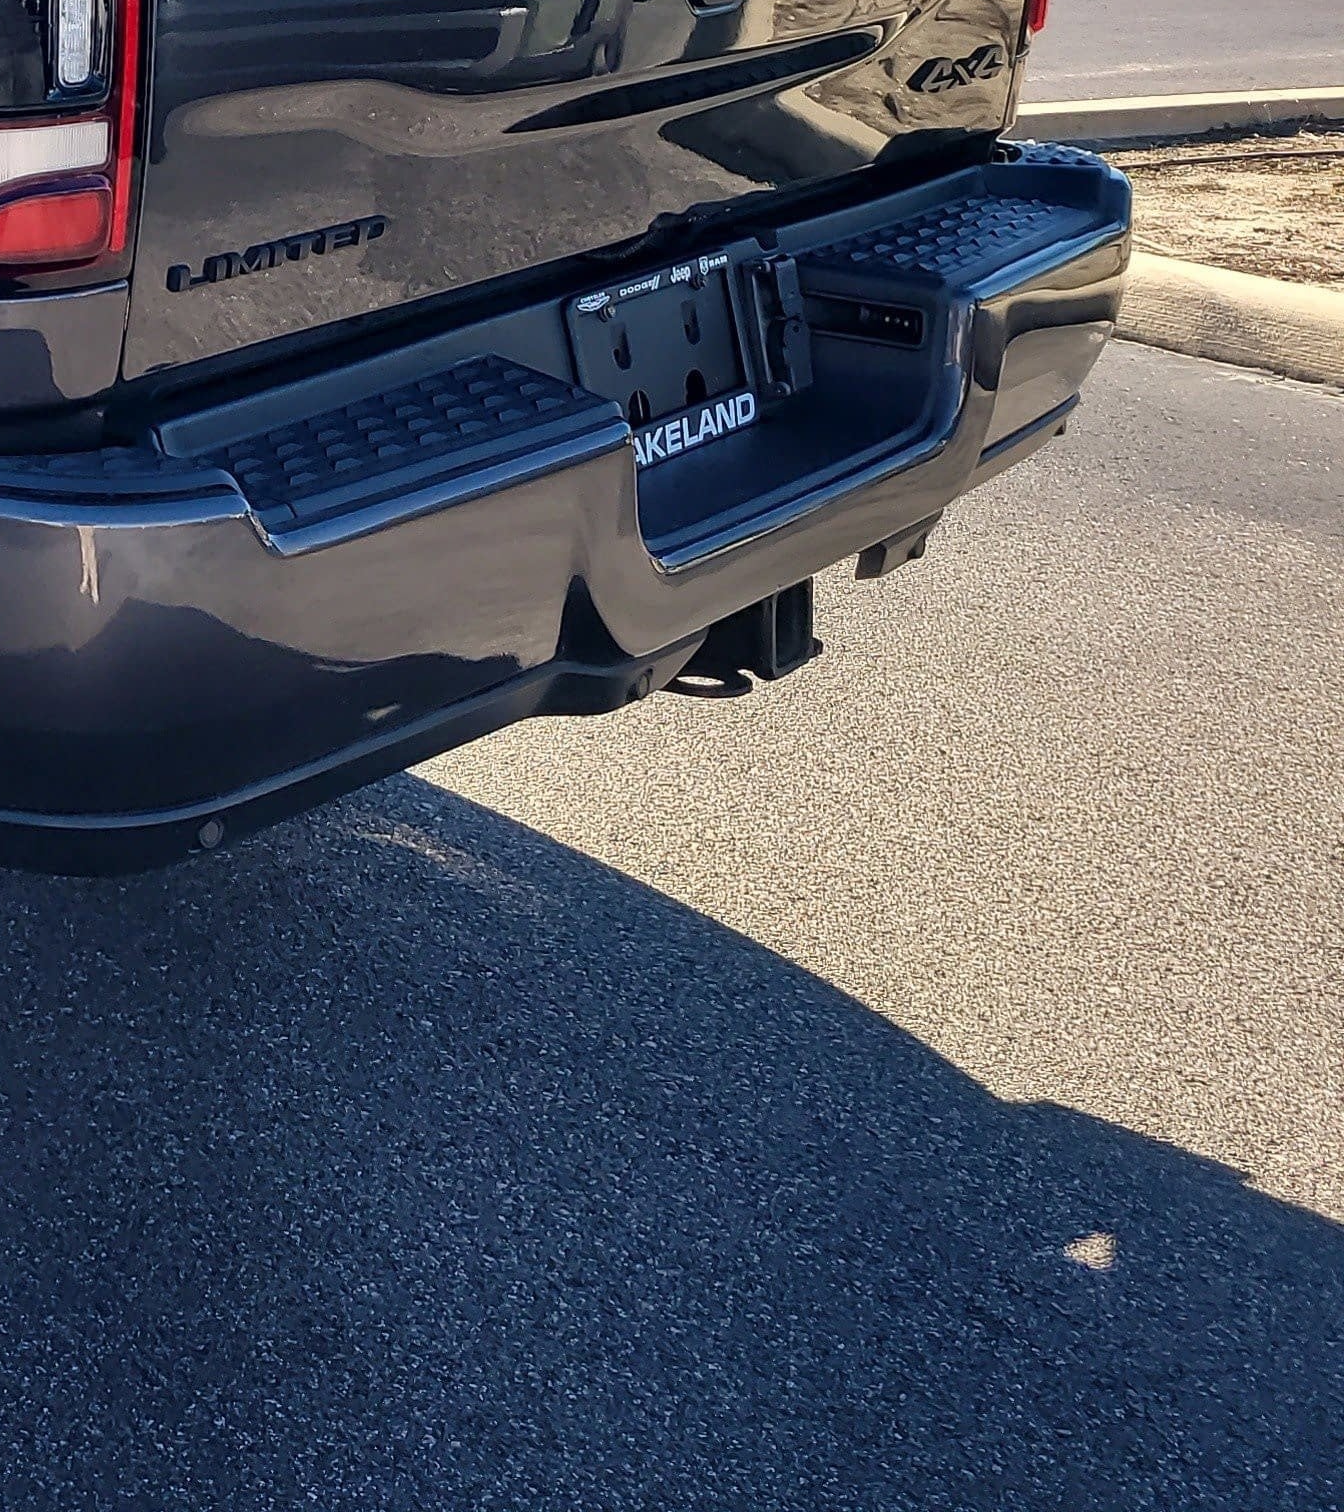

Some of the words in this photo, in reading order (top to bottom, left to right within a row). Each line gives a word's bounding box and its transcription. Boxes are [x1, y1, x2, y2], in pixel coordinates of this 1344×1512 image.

[166, 214, 390, 292] LIMITED
[670, 266, 691, 284] Jeep
[708, 255, 728, 267] RAM
[633, 392, 756, 466] AKELAND
